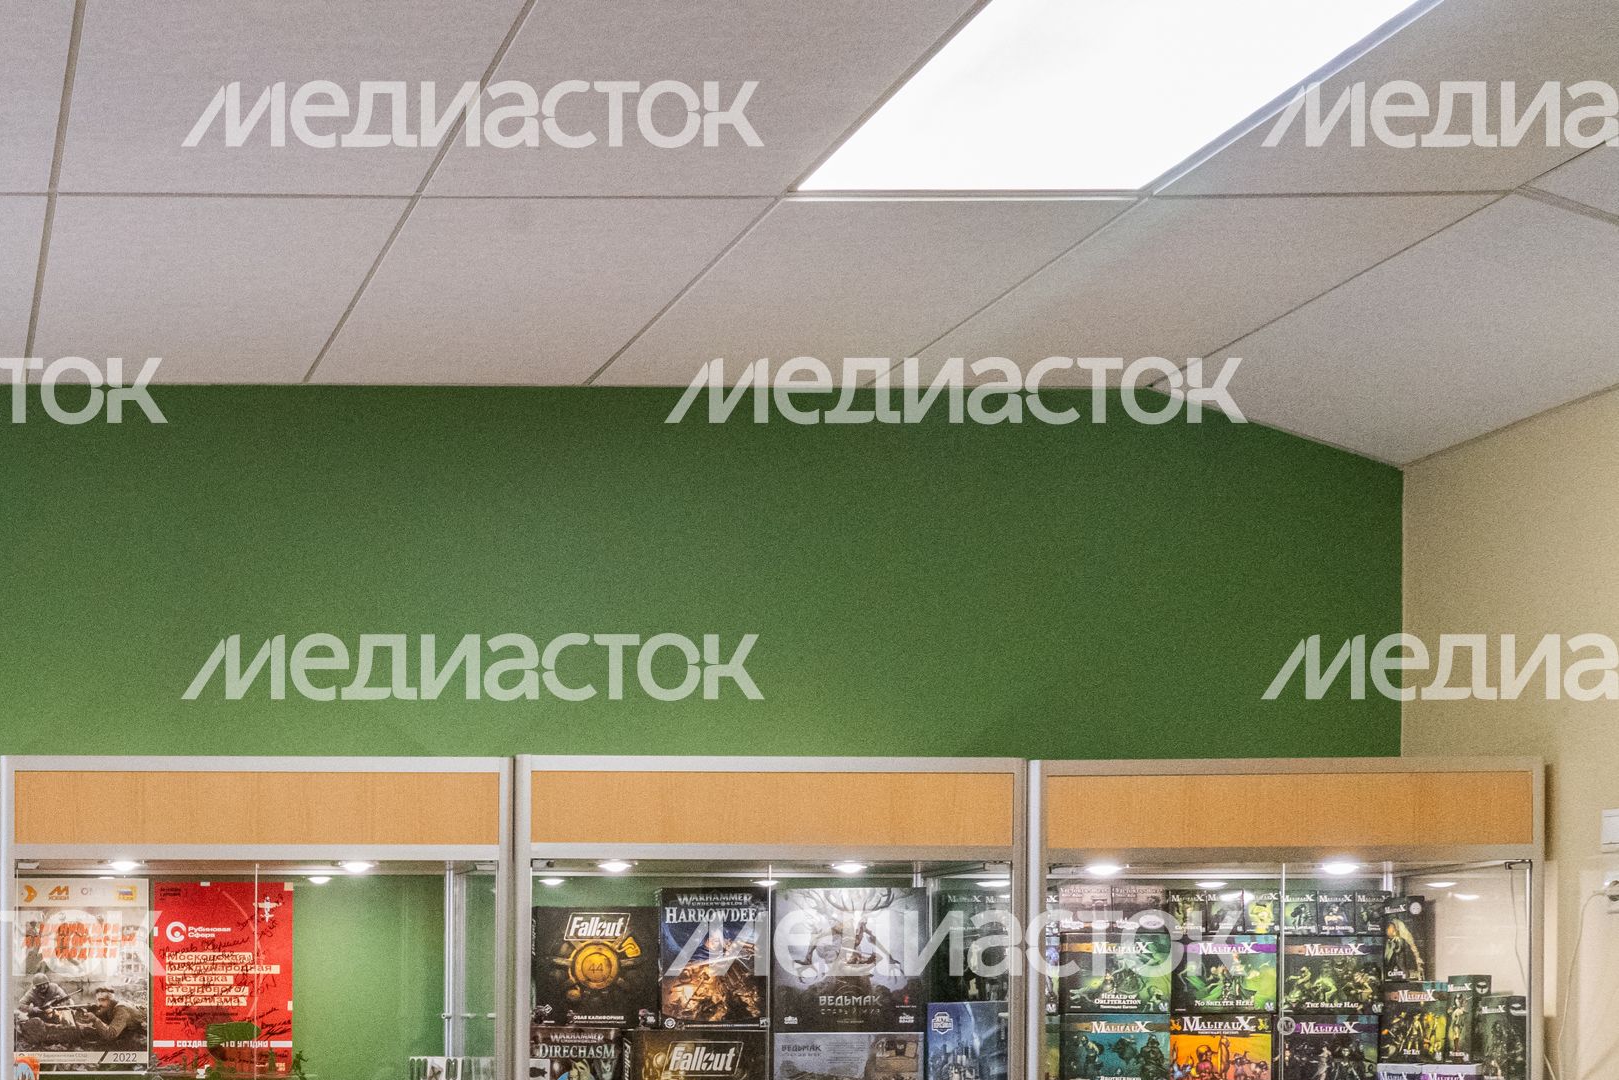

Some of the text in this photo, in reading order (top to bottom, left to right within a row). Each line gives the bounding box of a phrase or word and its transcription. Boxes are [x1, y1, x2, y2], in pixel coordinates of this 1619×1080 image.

[570, 917, 624, 937] Fallout
[1304, 943, 1369, 956] MALIFAUX
[819, 995, 882, 1006] ВЕДЬМАК
[1091, 1021, 1153, 1033] MALIFAUX
[1183, 1016, 1256, 1032] MALIFAUX
[1300, 1021, 1362, 1034] MALIFAUX
[113, 1053, 137, 1062] 2022
[539, 1044, 617, 1059] DIRECHASM
[670, 1047, 735, 1071] Fallout
